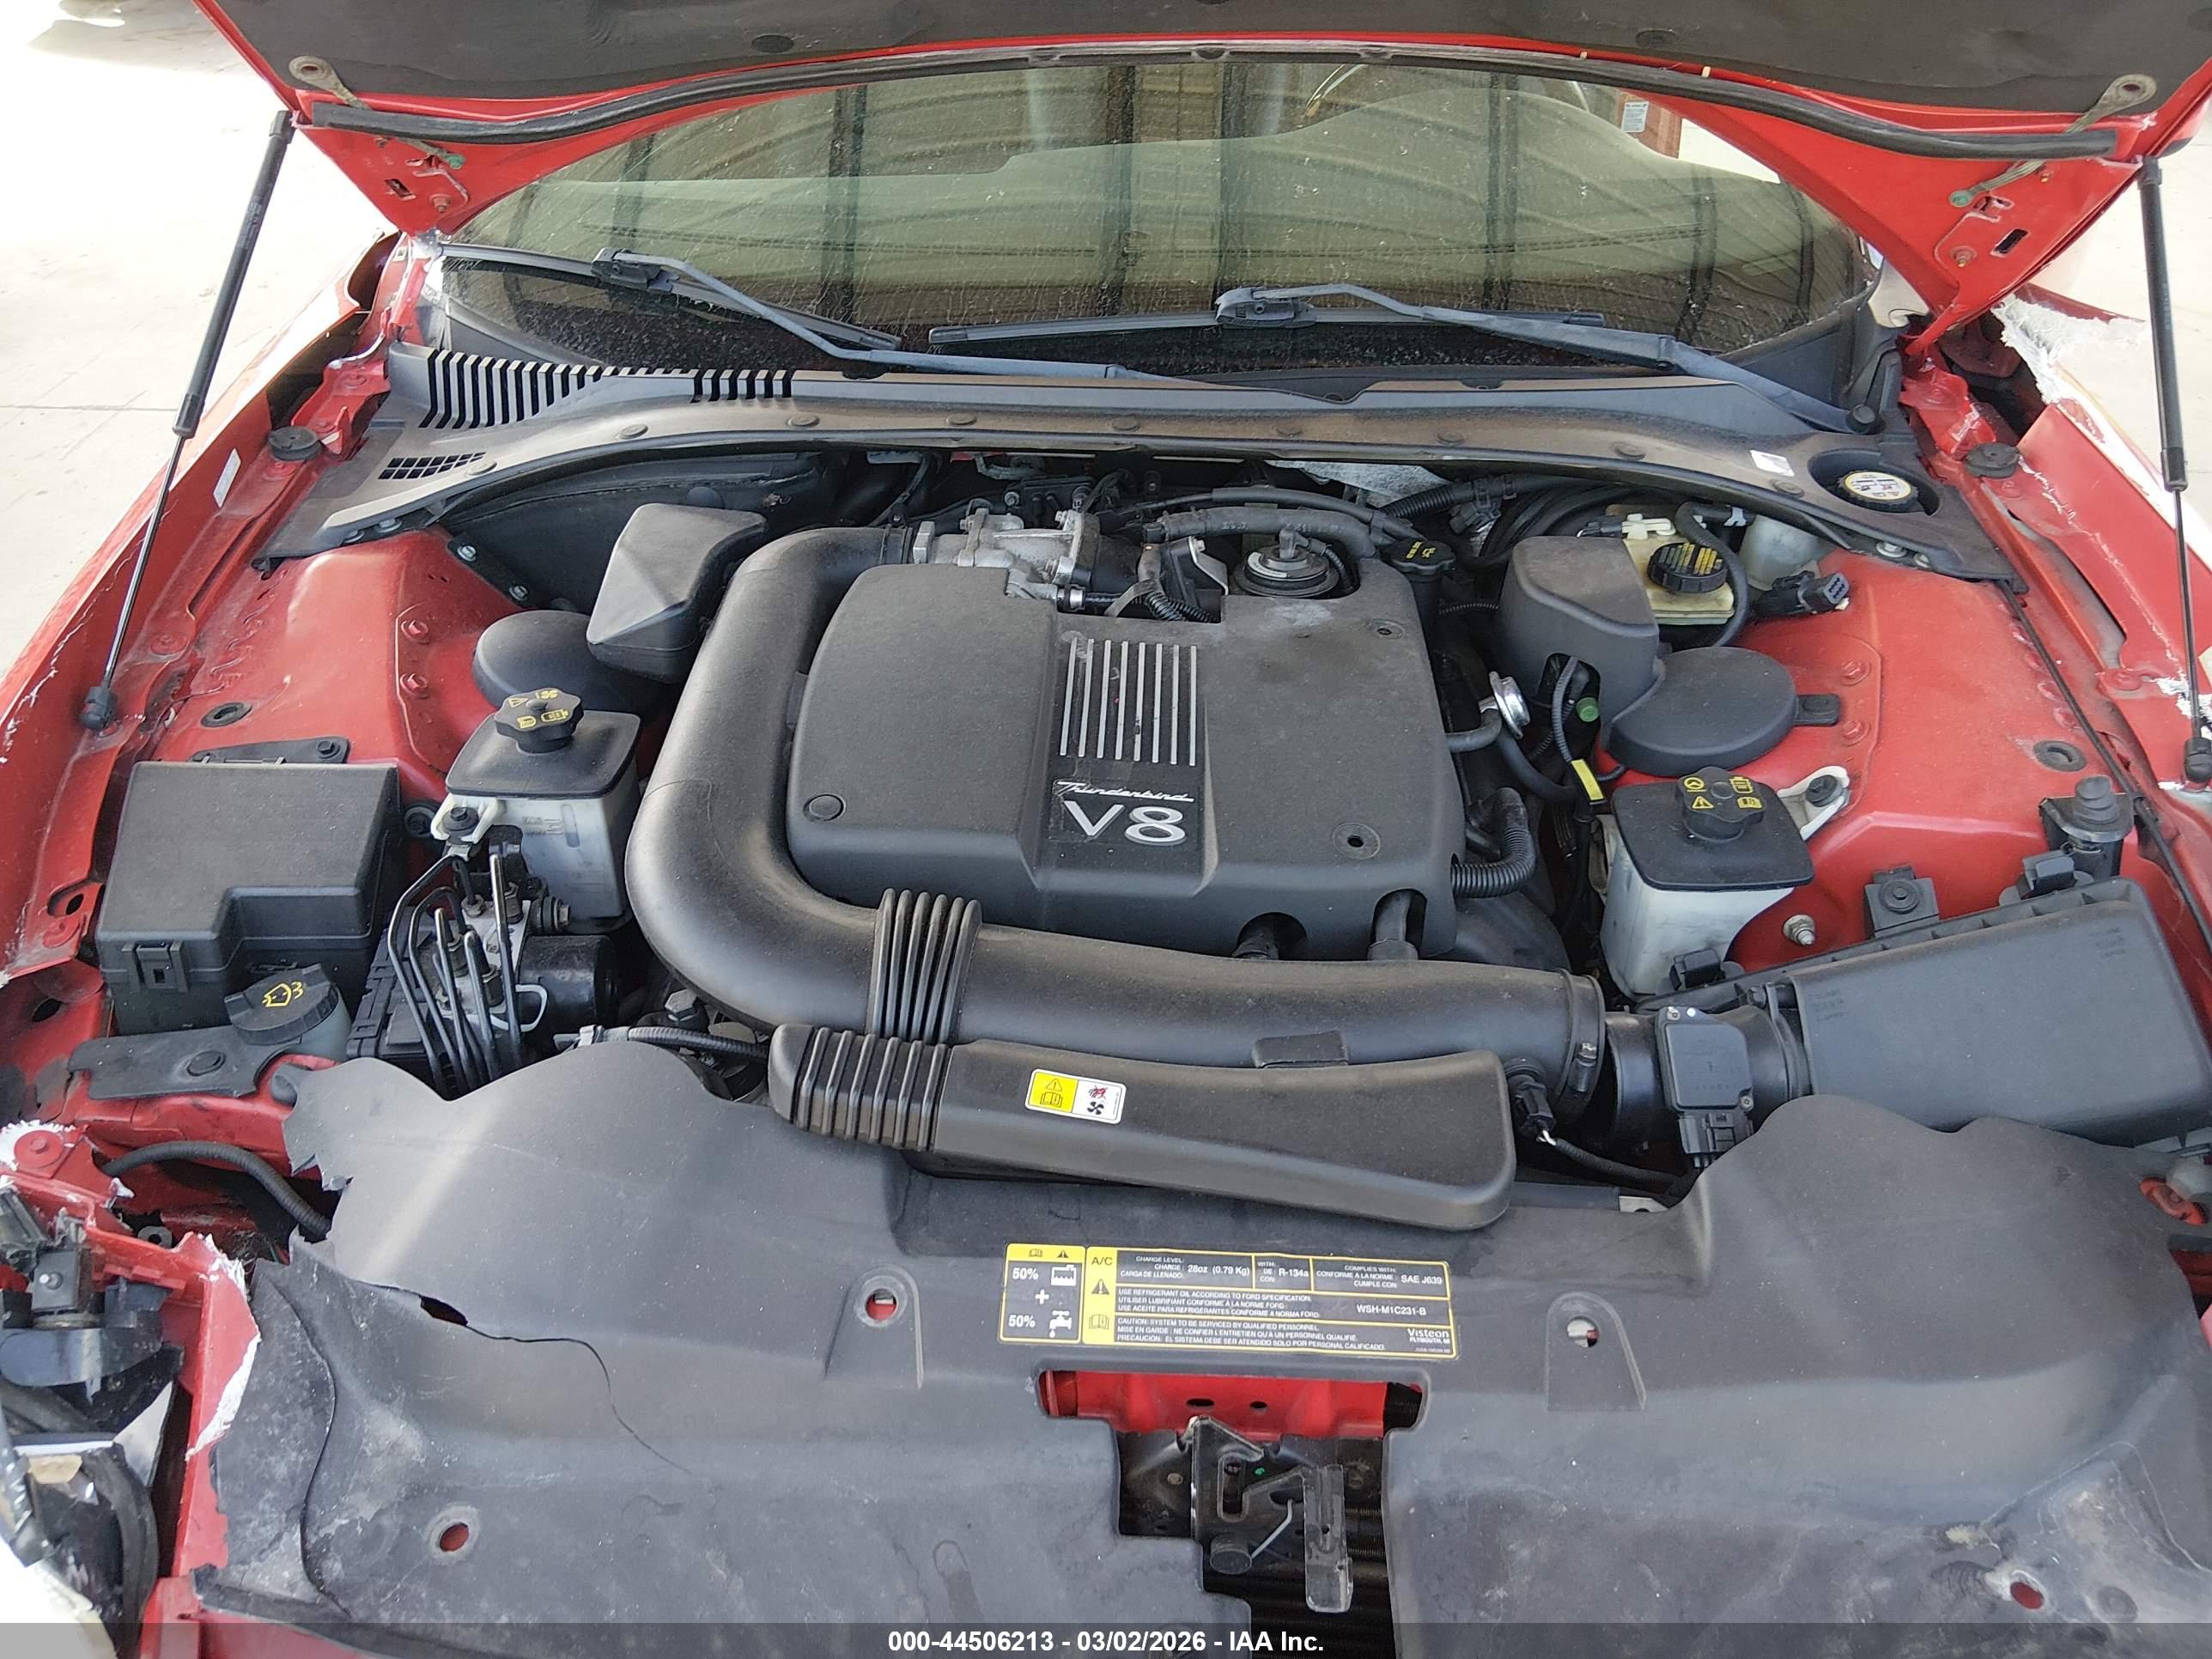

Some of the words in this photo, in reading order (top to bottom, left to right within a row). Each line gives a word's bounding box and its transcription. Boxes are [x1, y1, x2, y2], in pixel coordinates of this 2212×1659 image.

[1056, 781, 1195, 803] Thunderbird
[1064, 799, 1187, 846] V8
[1091, 1256, 1113, 1267] A/C
[1012, 1267, 1039, 1280] 50%
[1188, 1264, 1208, 1273] 28oz
[1212, 1265, 1234, 1275] (0.79
[1235, 1267, 1250, 1277] Kg)
[1279, 1267, 1309, 1278] R-134a
[1401, 1274, 1419, 1284] SAE
[1422, 1275, 1443, 1285] J639
[1133, 1289, 1178, 1297] REFRIGERANT
[1176, 1307, 1230, 1315] REFRIGERANTES
[1356, 1304, 1427, 1316] WSH-M1C231-B
[1008, 1314, 1036, 1328] 50%
[1285, 1332, 1325, 1340] PERSONNEL
[1407, 1328, 1449, 1338] Visteon
[1309, 1340, 1343, 1349] PERSONAL
